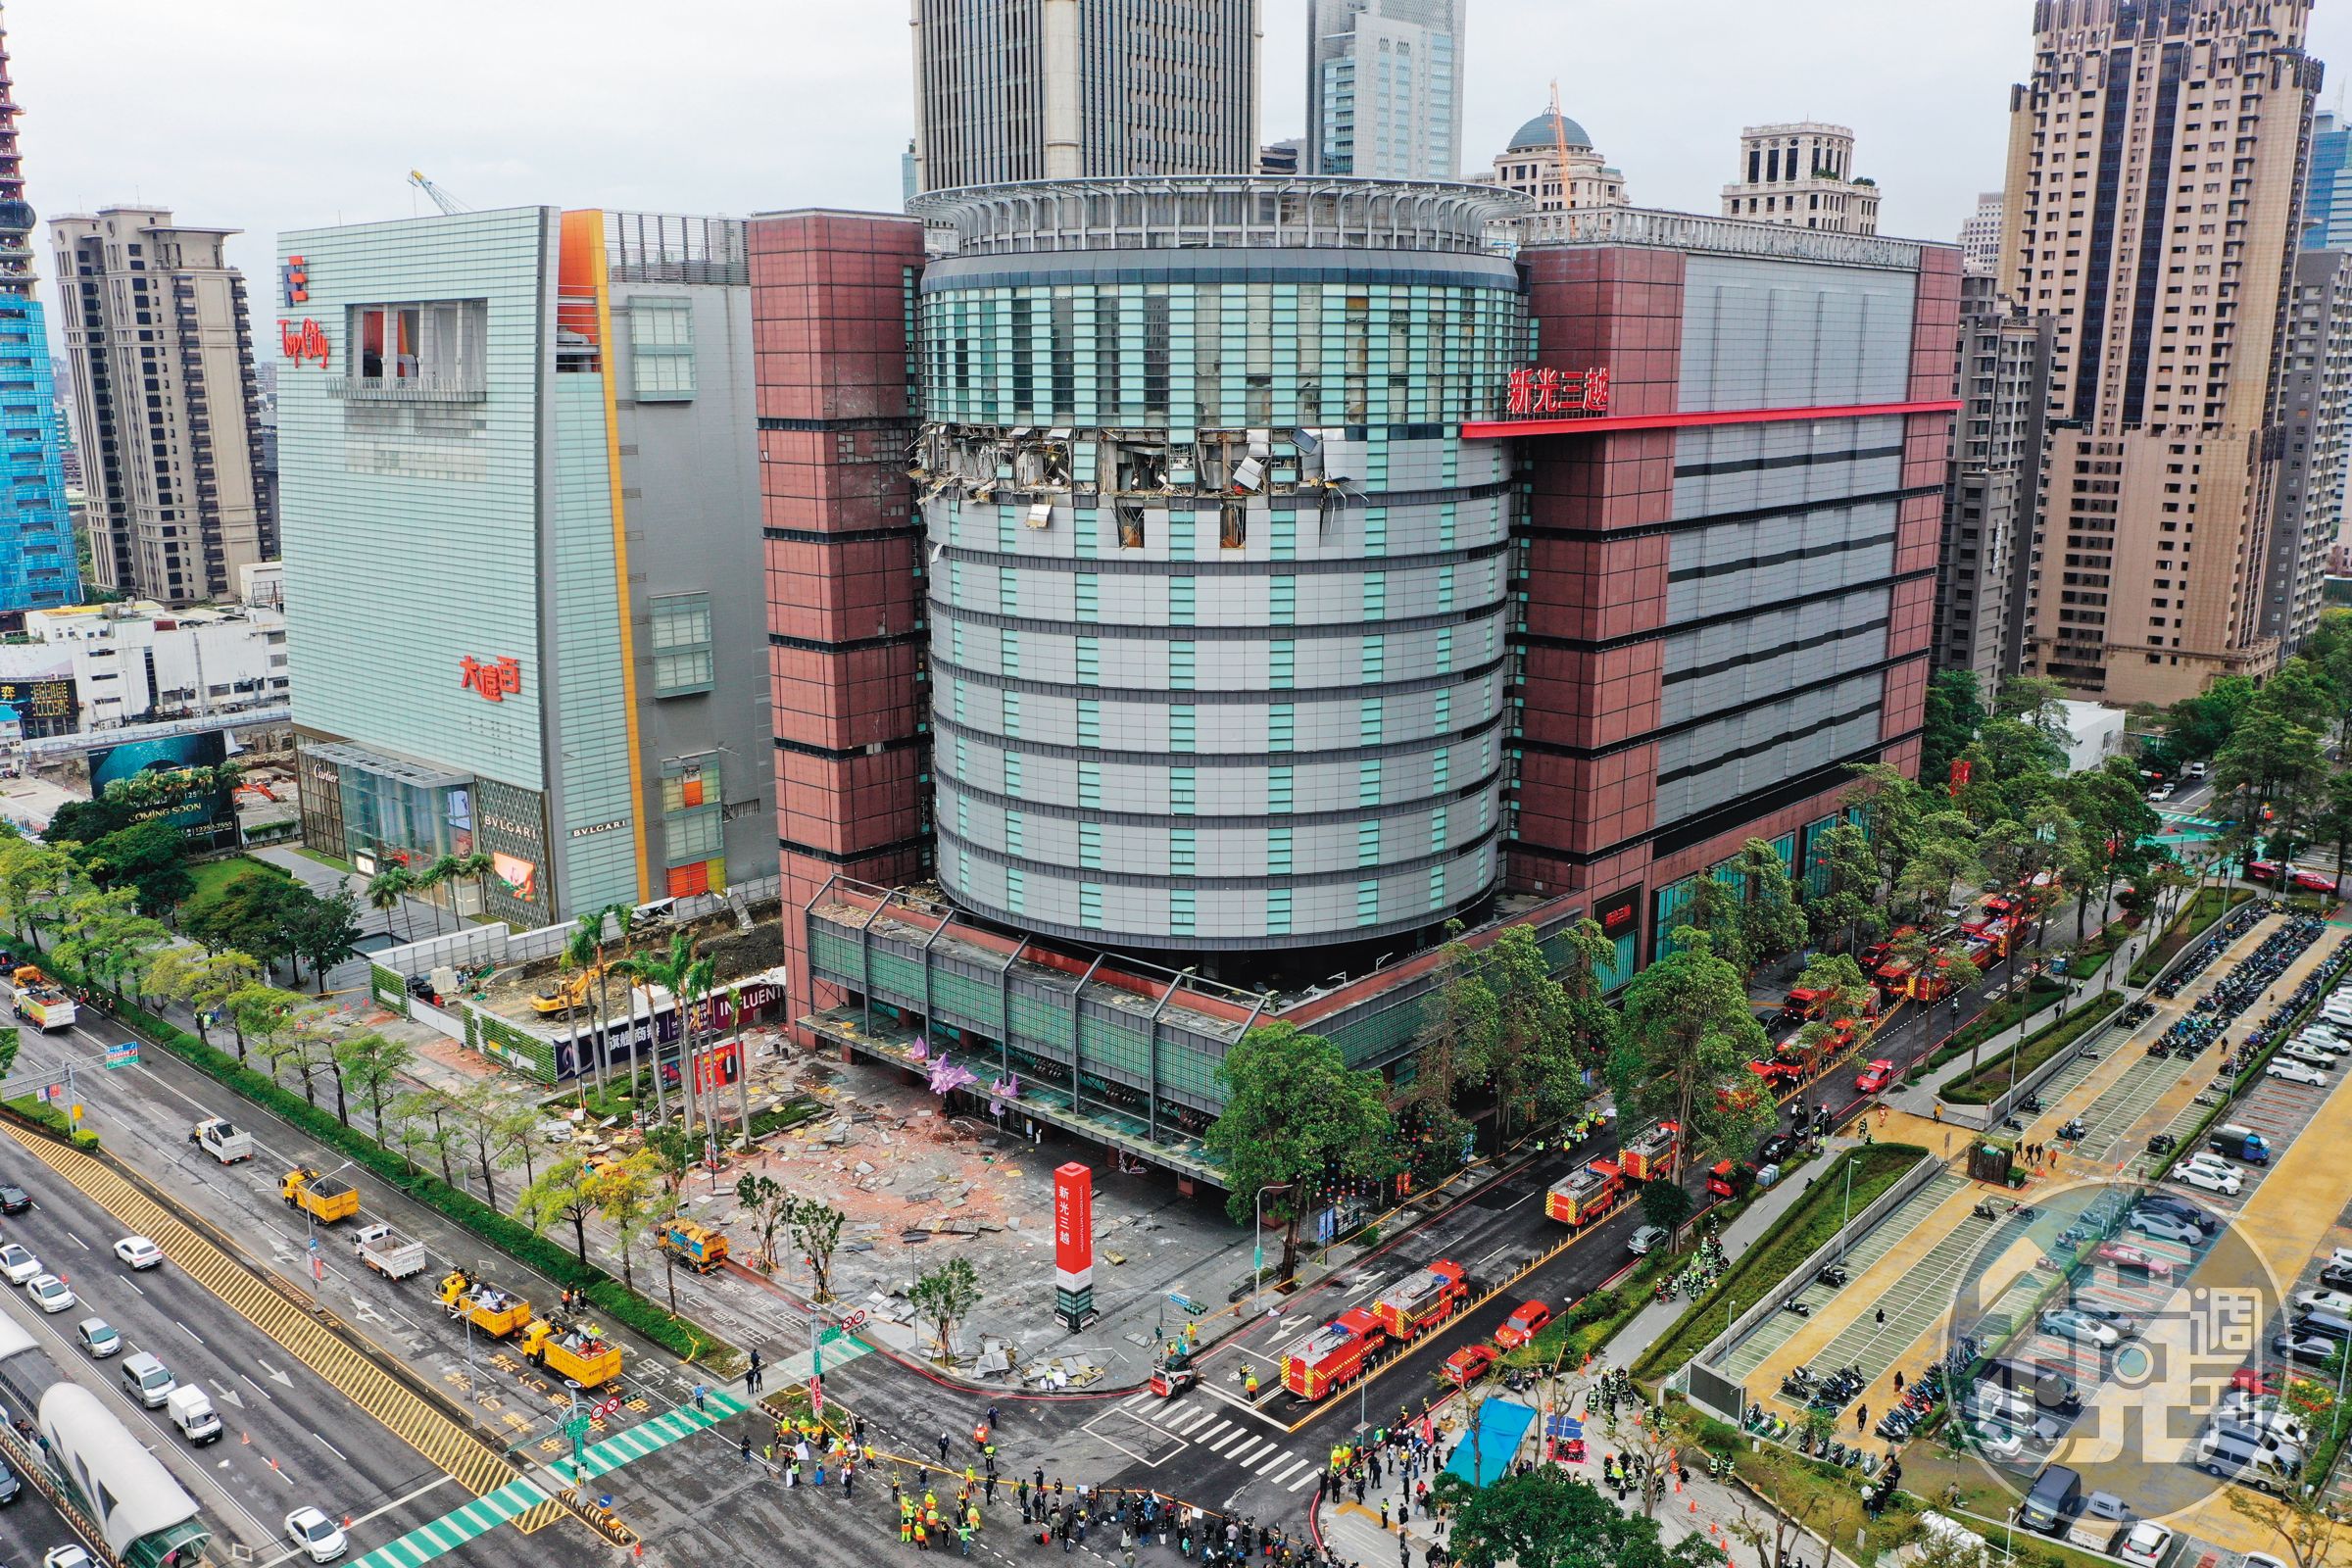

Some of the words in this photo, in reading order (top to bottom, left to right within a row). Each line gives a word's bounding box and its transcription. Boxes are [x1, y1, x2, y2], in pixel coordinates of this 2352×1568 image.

[1507, 368, 1609, 414] 新光三越
[460, 655, 521, 702] 大遠百
[314, 763, 339, 783] Cartier
[172, 802, 202, 816] SOON
[484, 814, 537, 840] BVLGARI
[573, 819, 626, 837] BVLGARI
[1058, 1185, 1070, 1246] 新光三越
